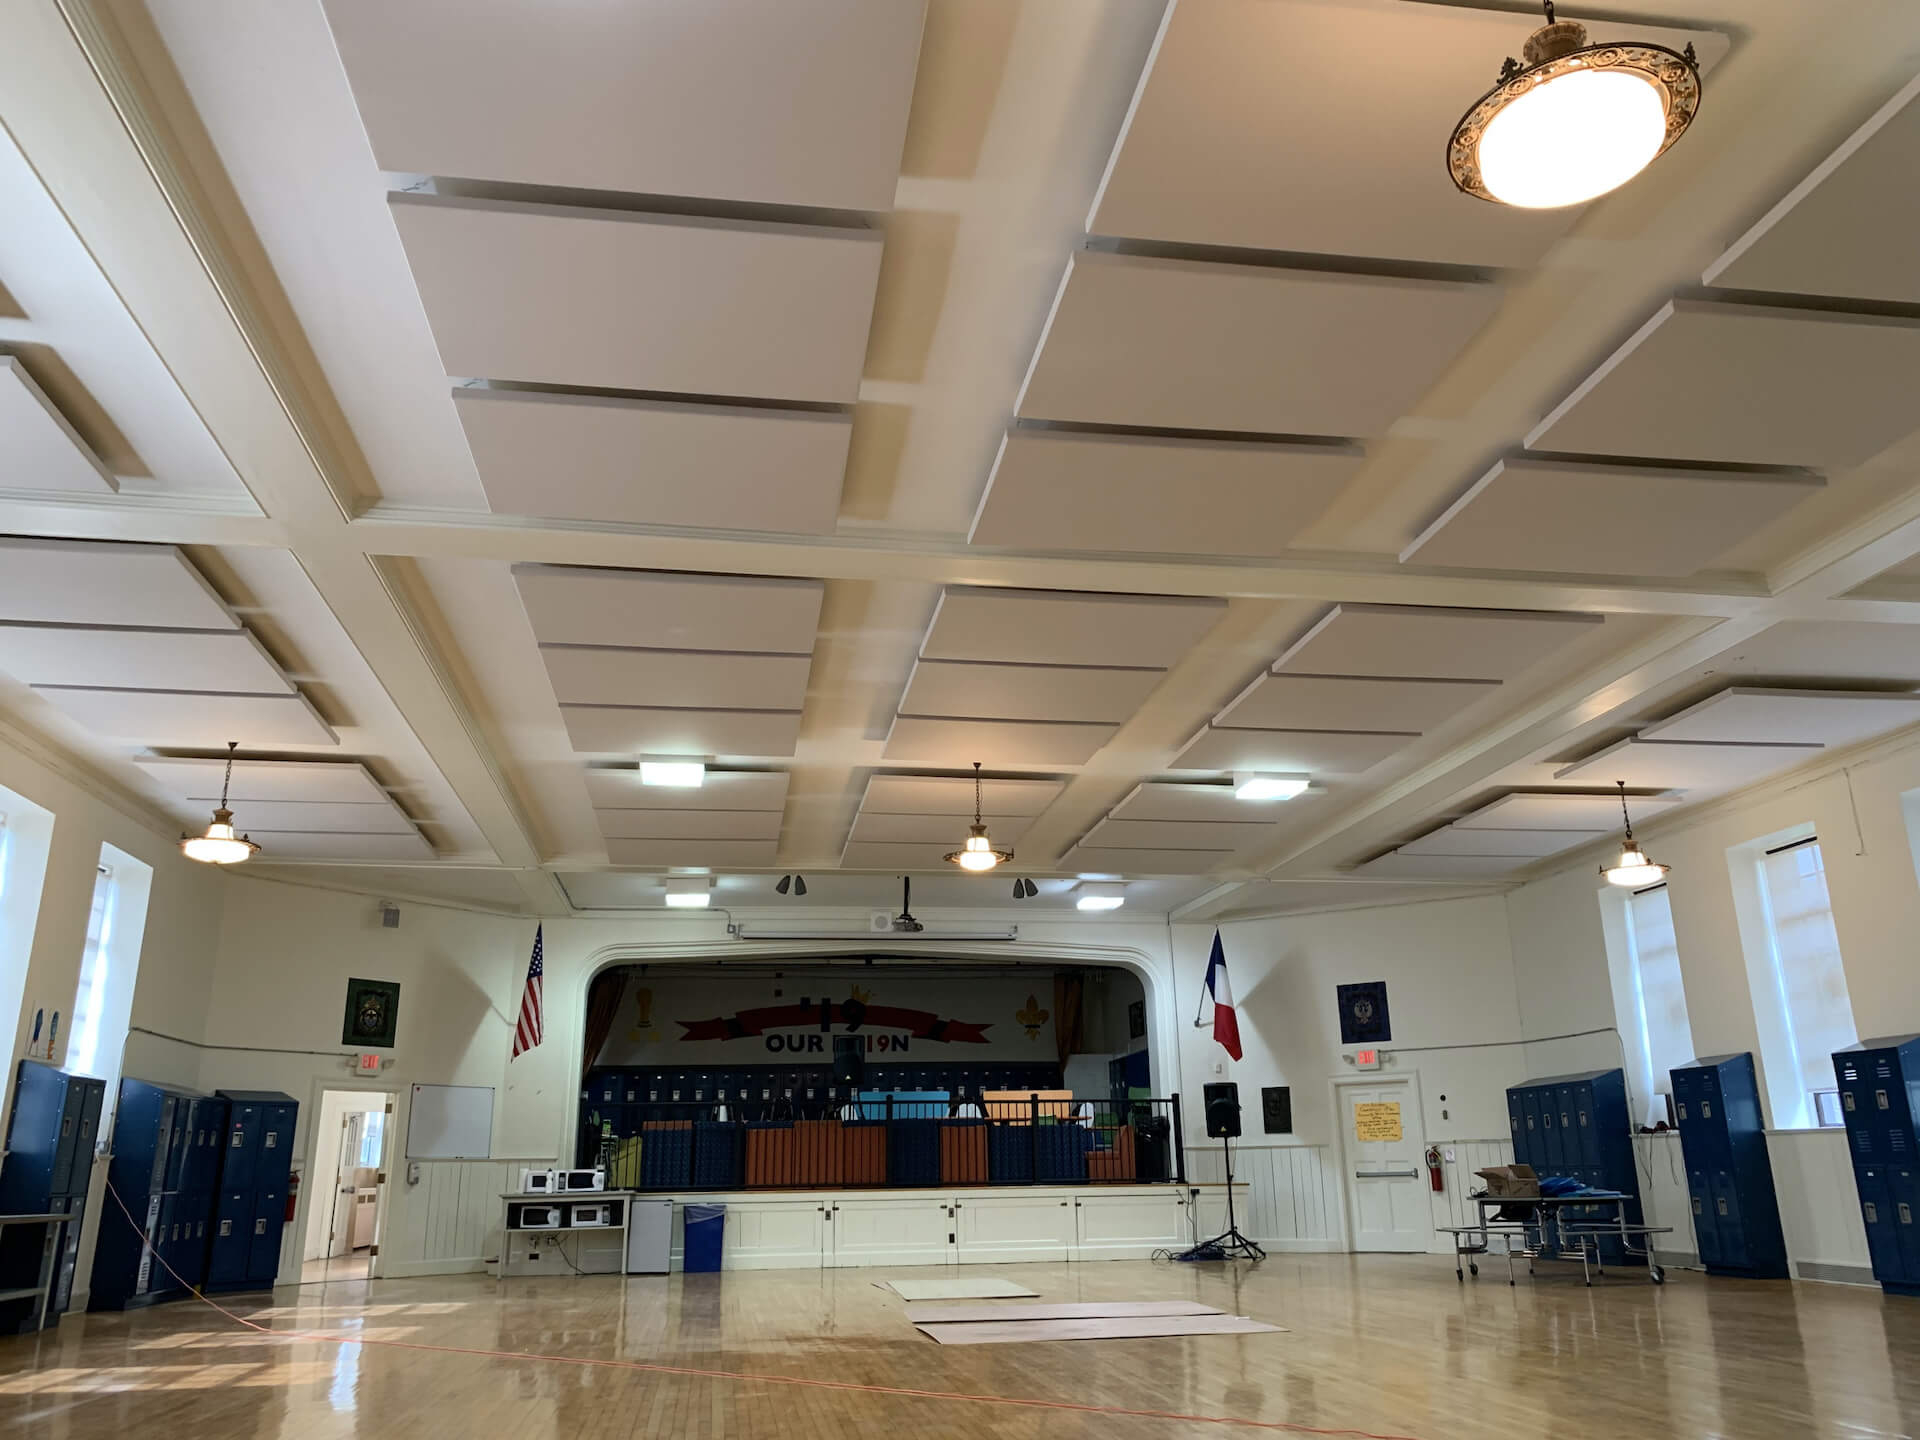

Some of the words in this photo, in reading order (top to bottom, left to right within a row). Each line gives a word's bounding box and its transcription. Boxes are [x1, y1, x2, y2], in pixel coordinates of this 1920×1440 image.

[766, 1034, 824, 1052] OUR
[361, 1055, 380, 1069] EXIT
[1358, 1051, 1375, 1064] EXIT
